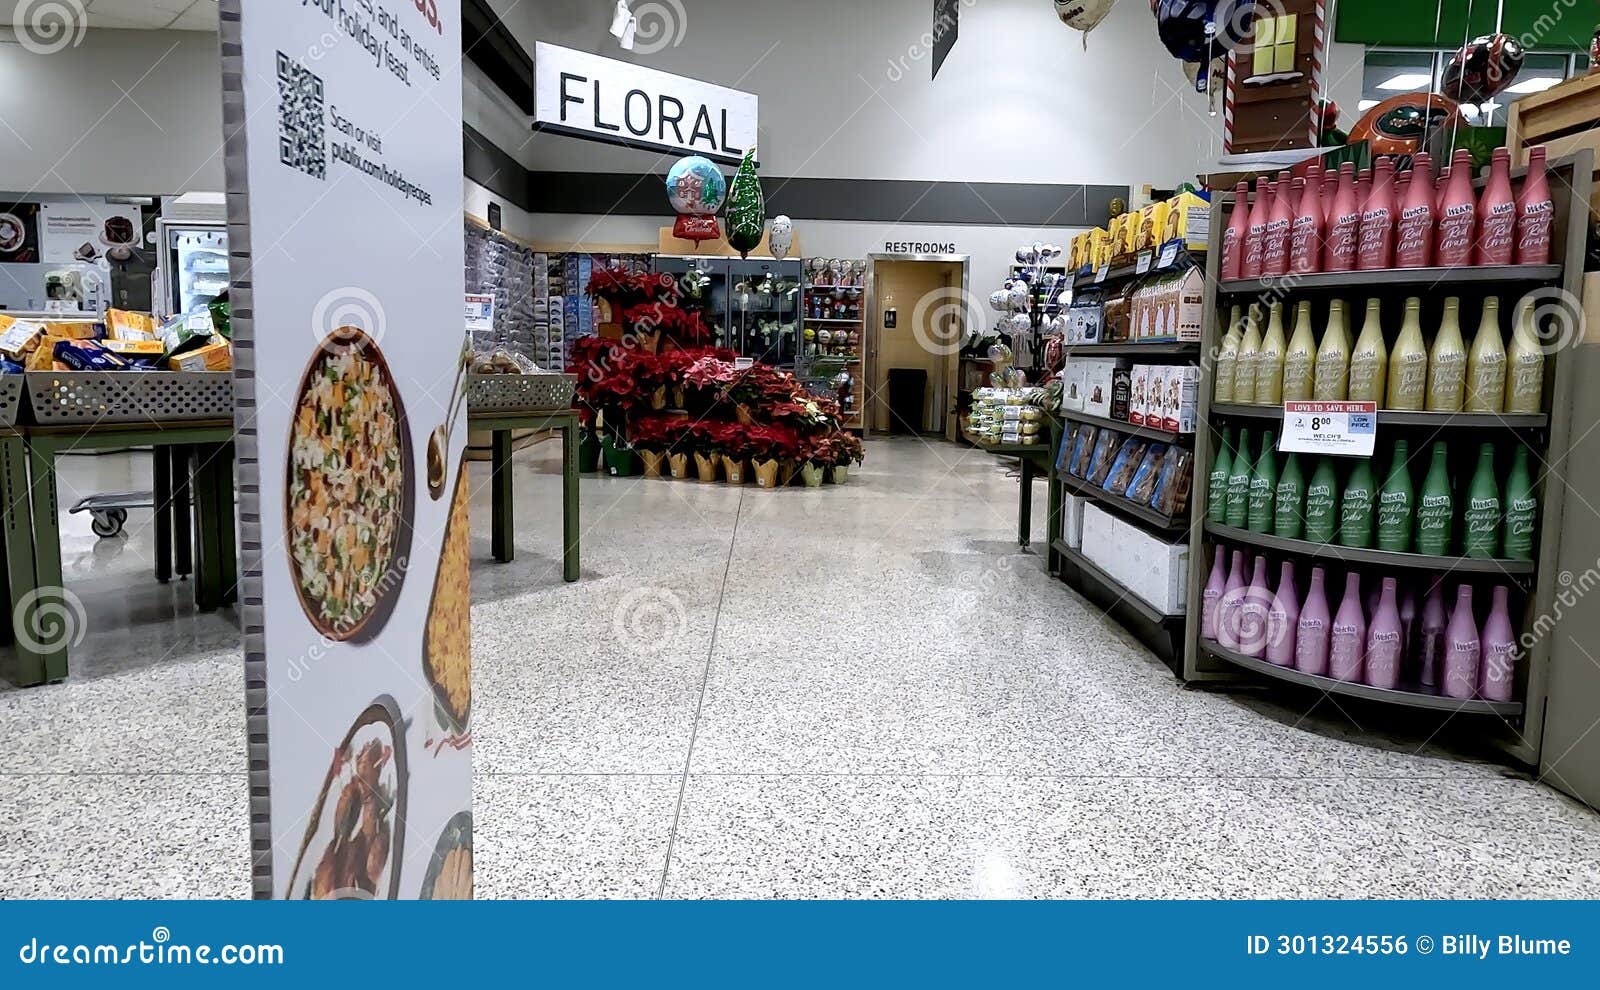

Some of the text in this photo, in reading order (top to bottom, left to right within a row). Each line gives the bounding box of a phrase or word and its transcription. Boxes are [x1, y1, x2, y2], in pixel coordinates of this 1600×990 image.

[338, 0, 382, 68] holiday
[384, 41, 411, 87] feast.
[378, 6, 398, 40] and
[401, 29, 412, 54] an
[413, 43, 440, 80] entrée
[560, 71, 743, 155] FLORAL
[330, 105, 382, 155] Scan or visit
[885, 242, 956, 254] RESTROOMS
[1294, 404, 1313, 412] LOVE
[1315, 404, 1323, 412] TO
[1327, 404, 1343, 412] SAVE
[1421, 517, 1446, 529] Cider
[1469, 520, 1497, 533] Cider
